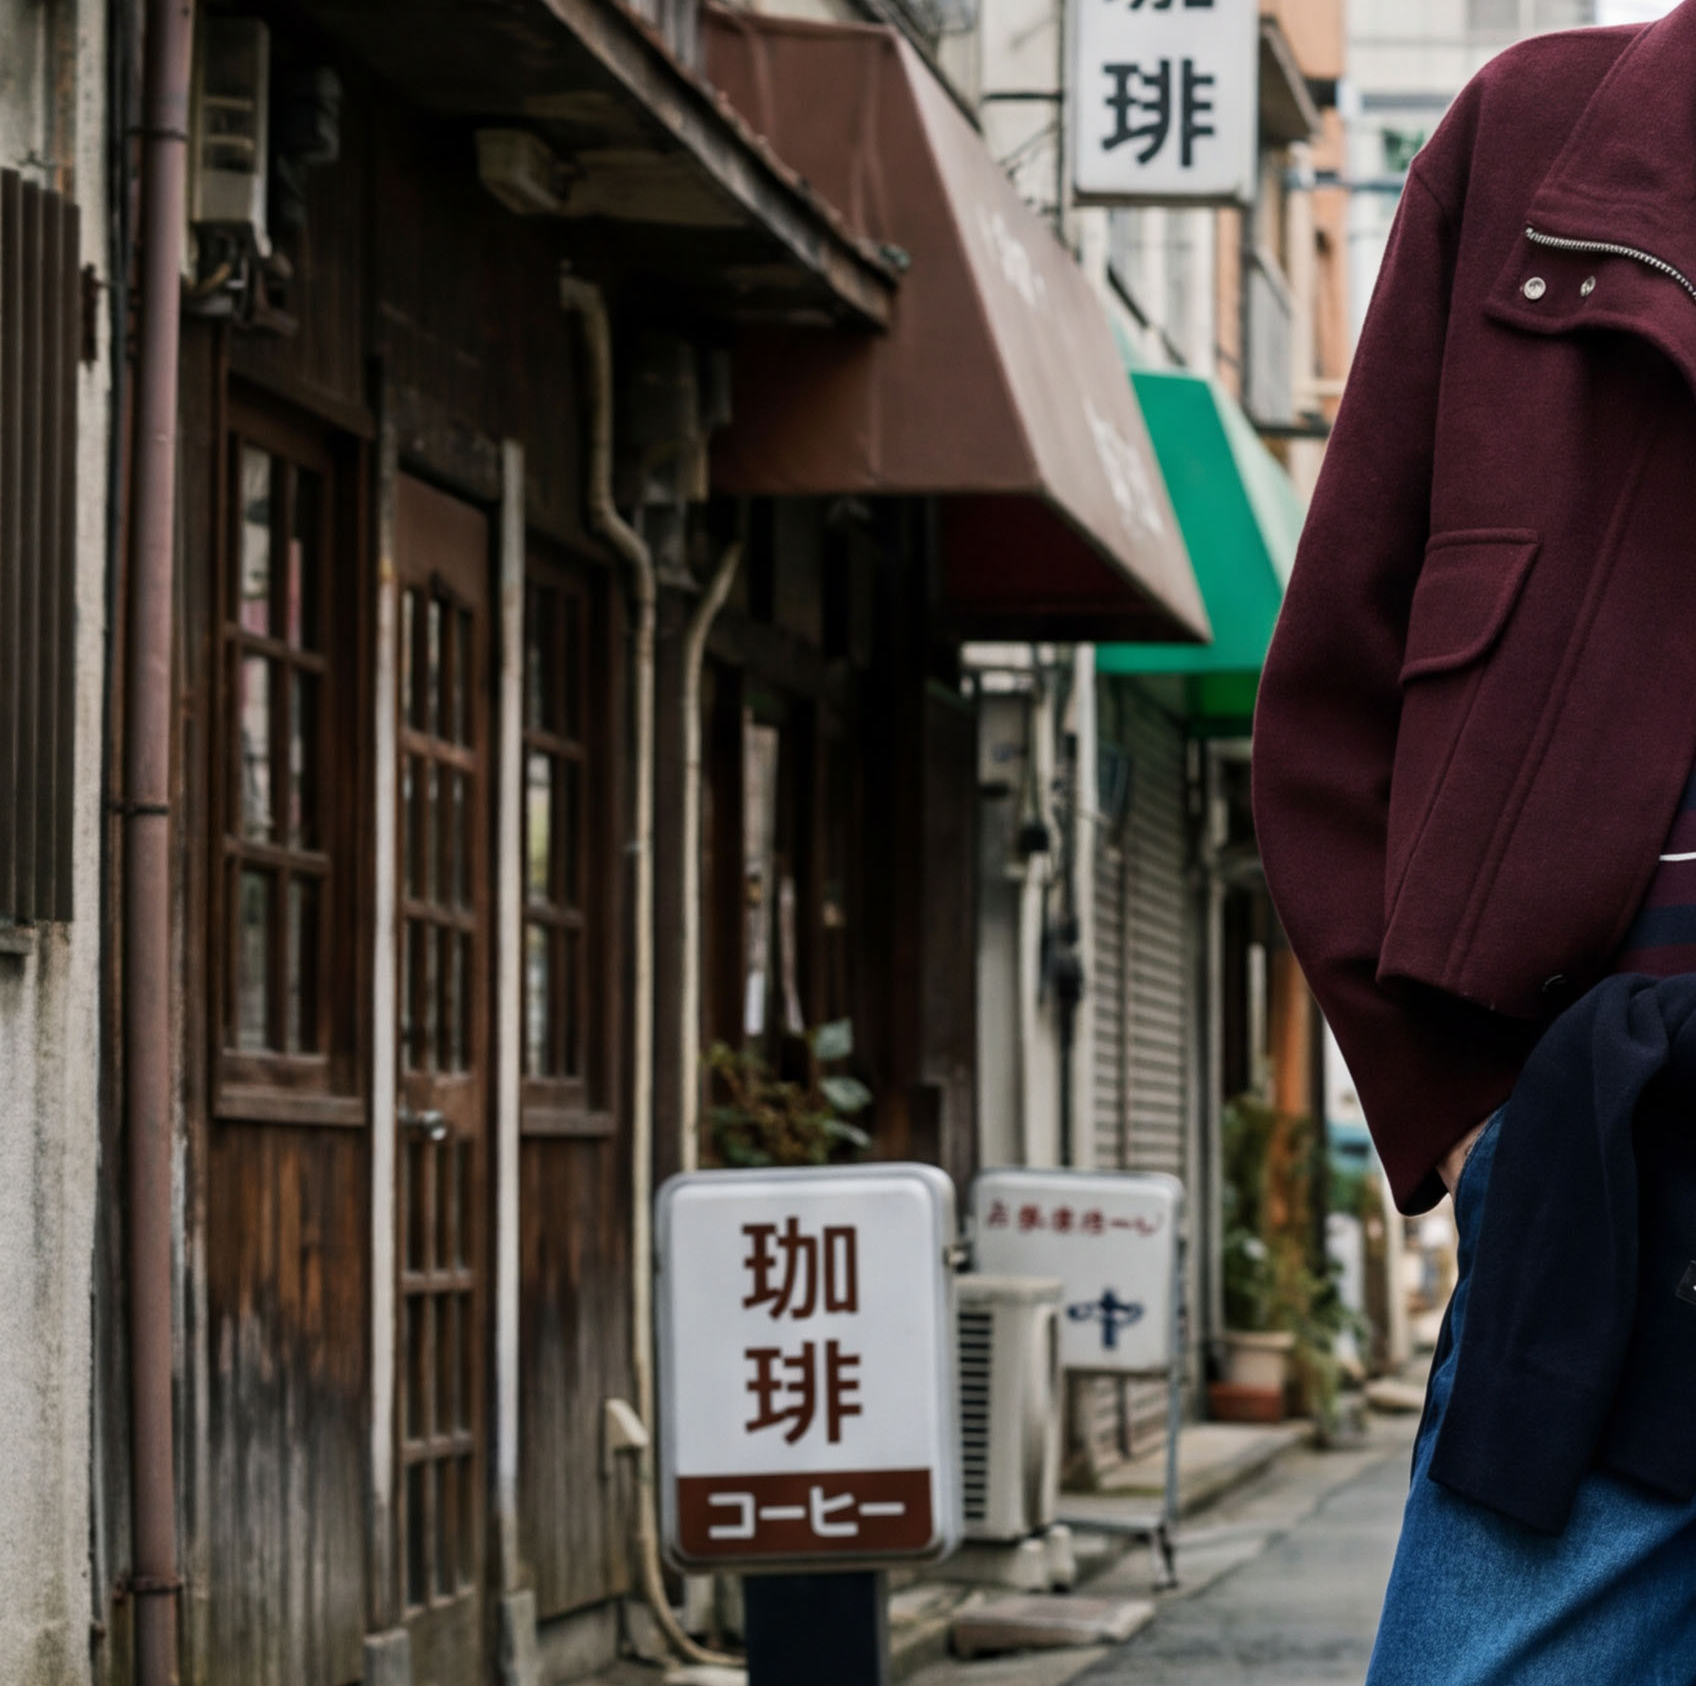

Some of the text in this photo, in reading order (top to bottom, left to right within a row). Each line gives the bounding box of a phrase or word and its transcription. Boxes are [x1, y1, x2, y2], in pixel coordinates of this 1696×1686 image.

[741, 1215, 863, 1446] 珈琲
[708, 1485, 906, 1539] コーヒー
